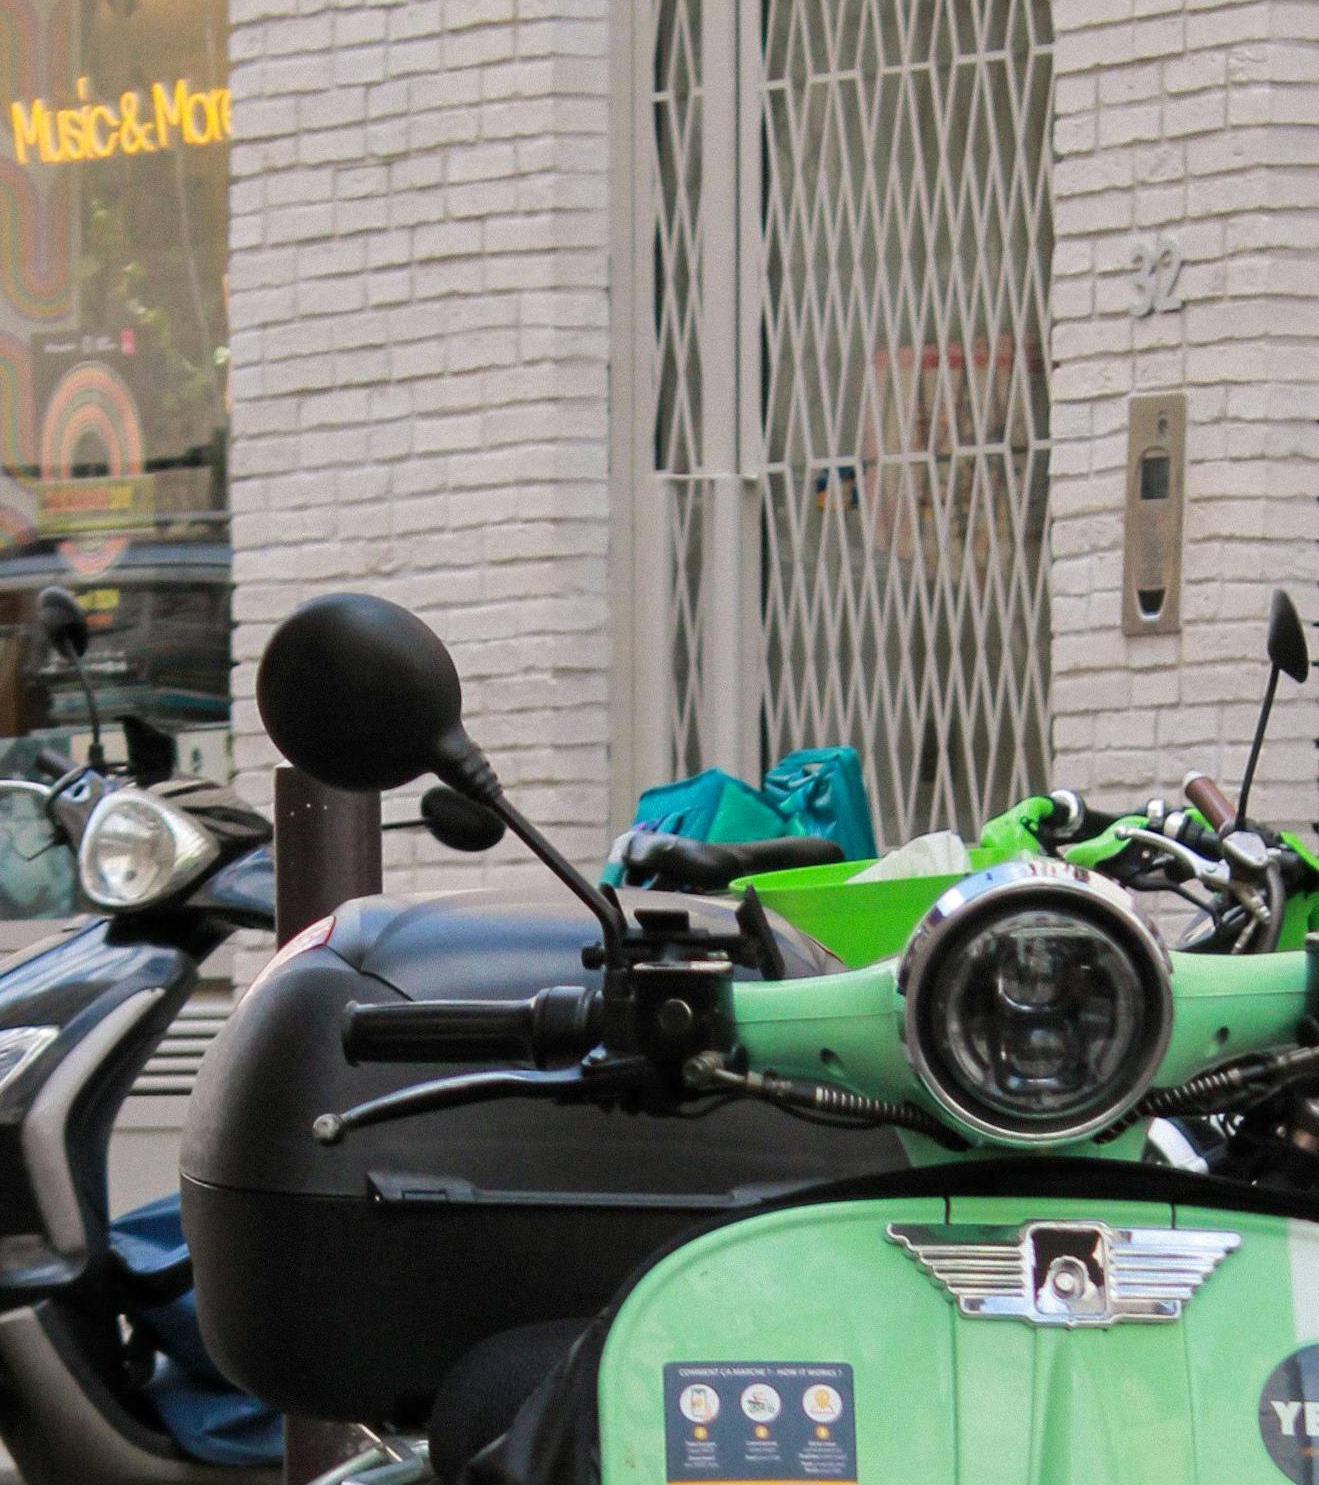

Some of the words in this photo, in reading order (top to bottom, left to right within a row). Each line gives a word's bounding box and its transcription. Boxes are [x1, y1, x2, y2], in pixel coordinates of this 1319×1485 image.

[11, 77, 119, 164] Music
[120, 91, 157, 154] &
[1128, 233, 1186, 318] 32
